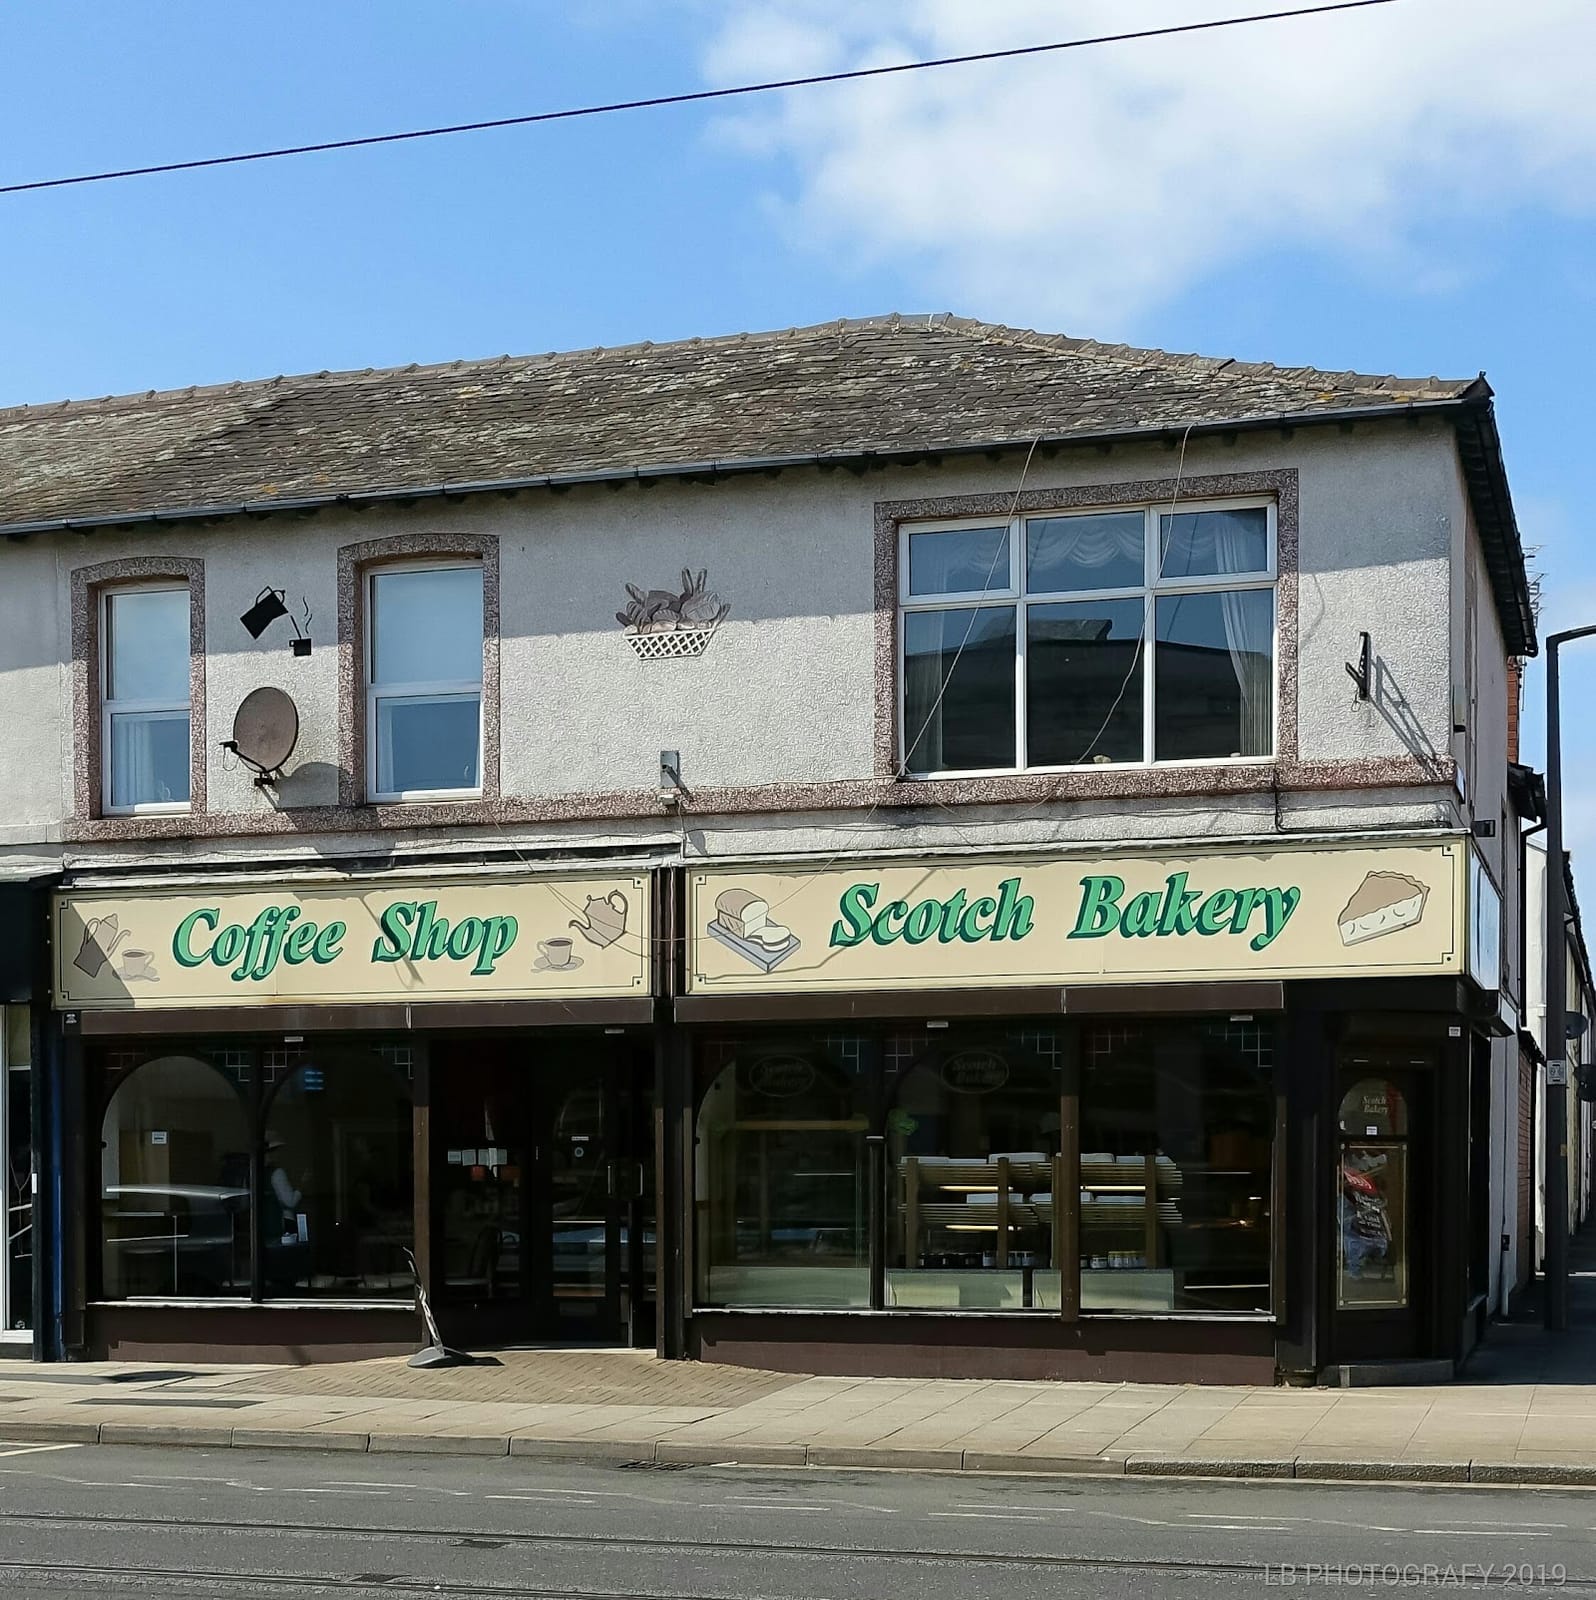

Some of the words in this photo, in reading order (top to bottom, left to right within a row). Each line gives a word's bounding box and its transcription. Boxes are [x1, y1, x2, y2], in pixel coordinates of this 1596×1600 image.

[829, 878, 1034, 947] Scotch
[1067, 871, 1301, 952] Bakery
[172, 905, 346, 982] Coffee
[371, 901, 518, 976] Shop
[1362, 1095, 1387, 1105] Scotch
[1364, 1104, 1389, 1115] Bakery
